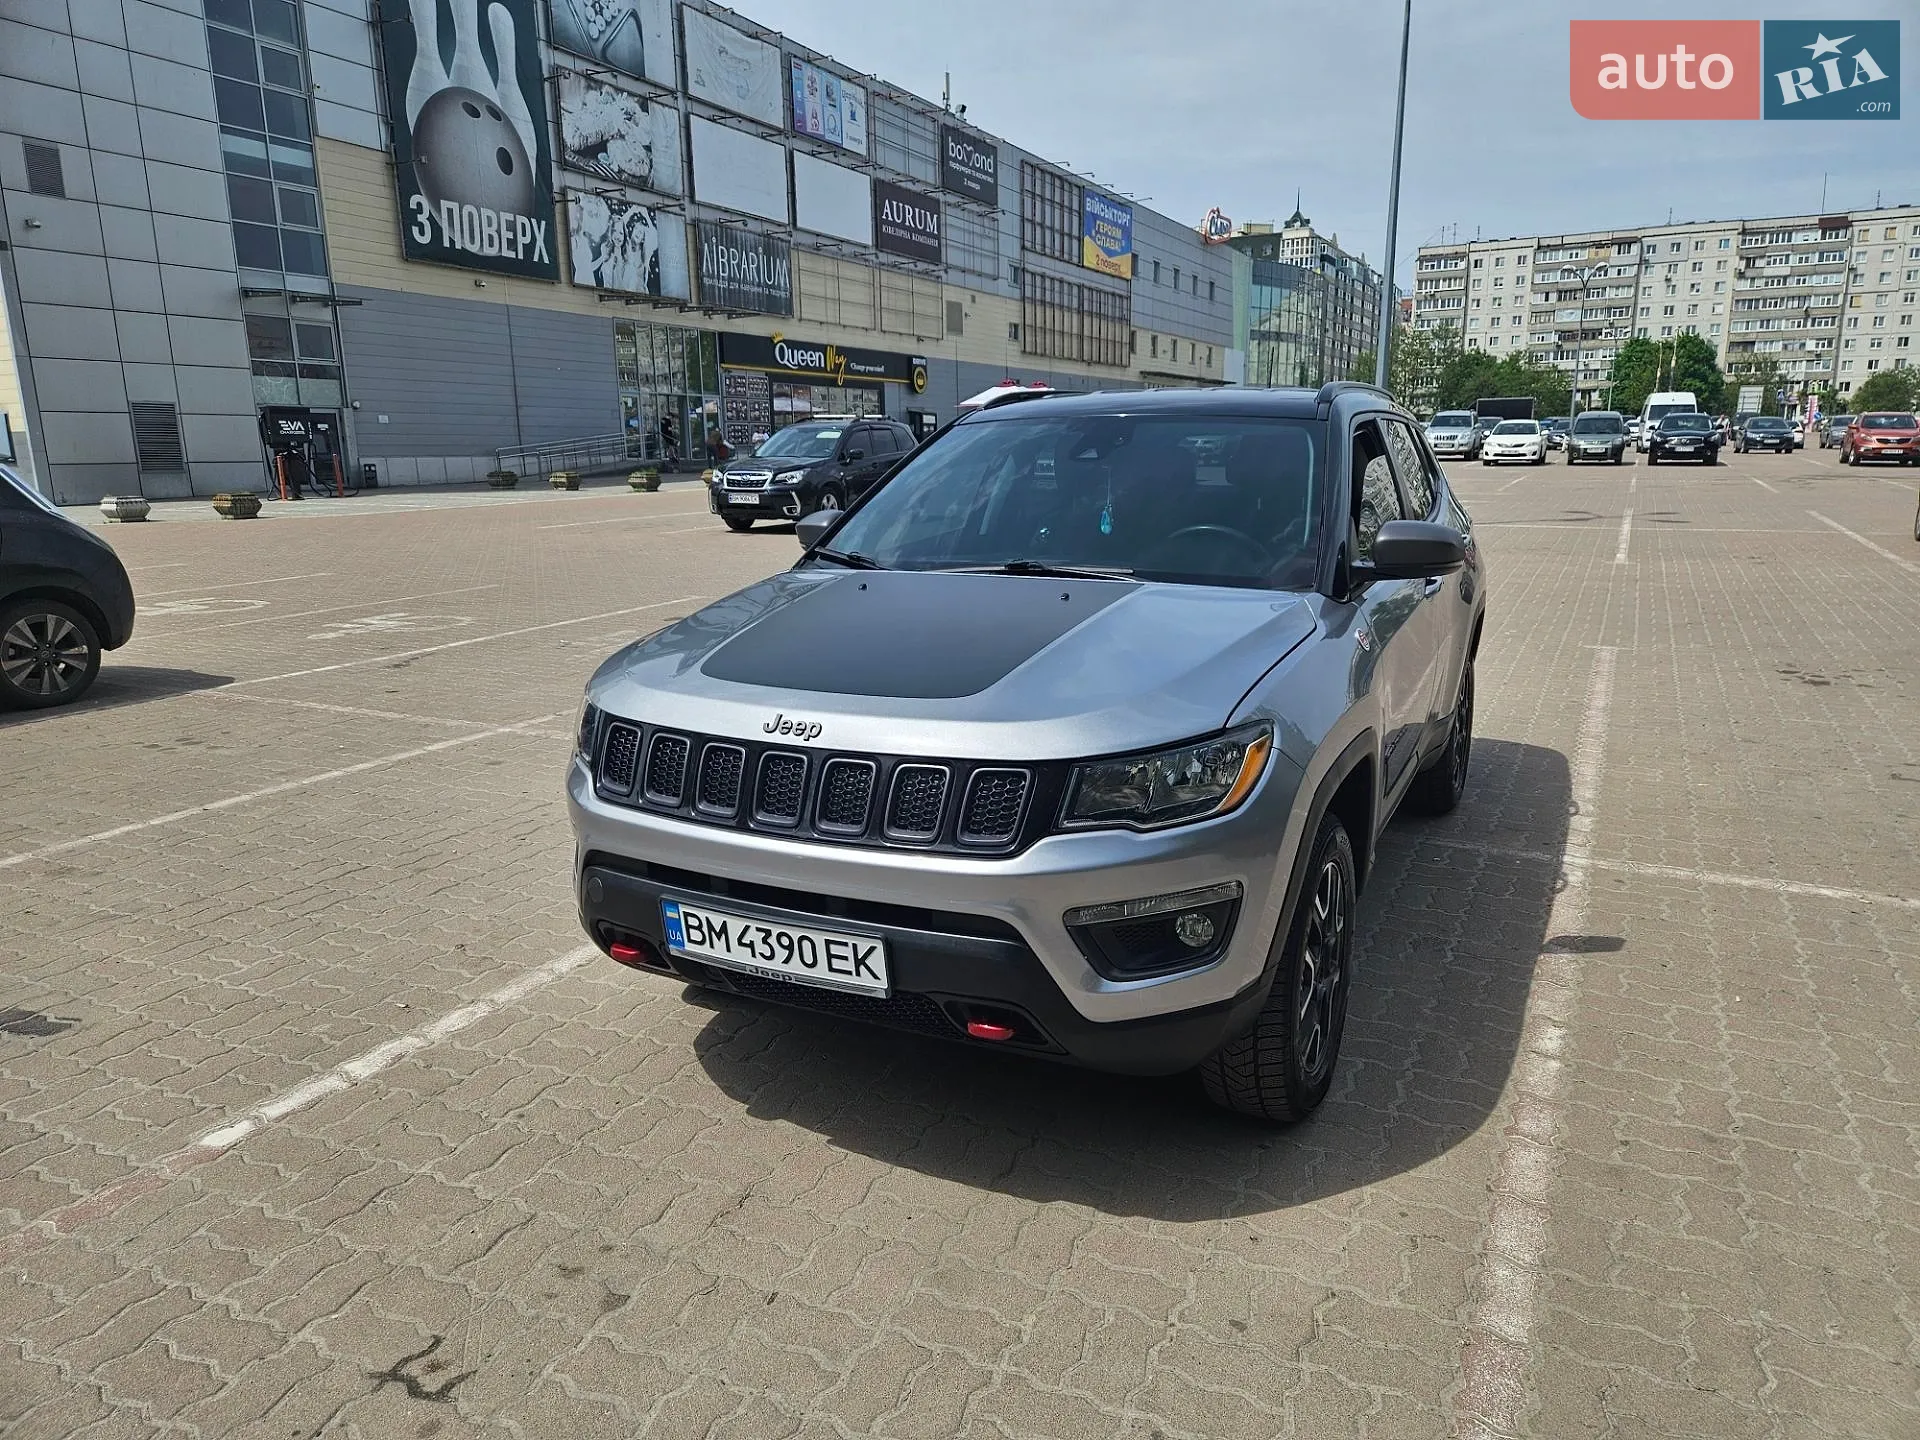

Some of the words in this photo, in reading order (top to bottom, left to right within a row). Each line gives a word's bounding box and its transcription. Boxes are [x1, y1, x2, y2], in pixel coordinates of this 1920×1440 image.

[882, 199, 938, 235] AURUM
[1086, 197, 1130, 227] ВІЙСЬКТОРГ
[409, 194, 432, 245] 3
[440, 199, 550, 264] ПОВЕРХ
[1095, 220, 1122, 239] ГЕРОЯМ
[1095, 254, 1100, 266] 2
[774, 342, 825, 369] Queen
[826, 344, 847, 386] Way
[278, 420, 305, 430] EVA
[762, 713, 822, 741] Jeep
[668, 928, 683, 942] UA
[682, 910, 731, 953] BM
[737, 924, 818, 969] 4390
[823, 938, 882, 981] EK
